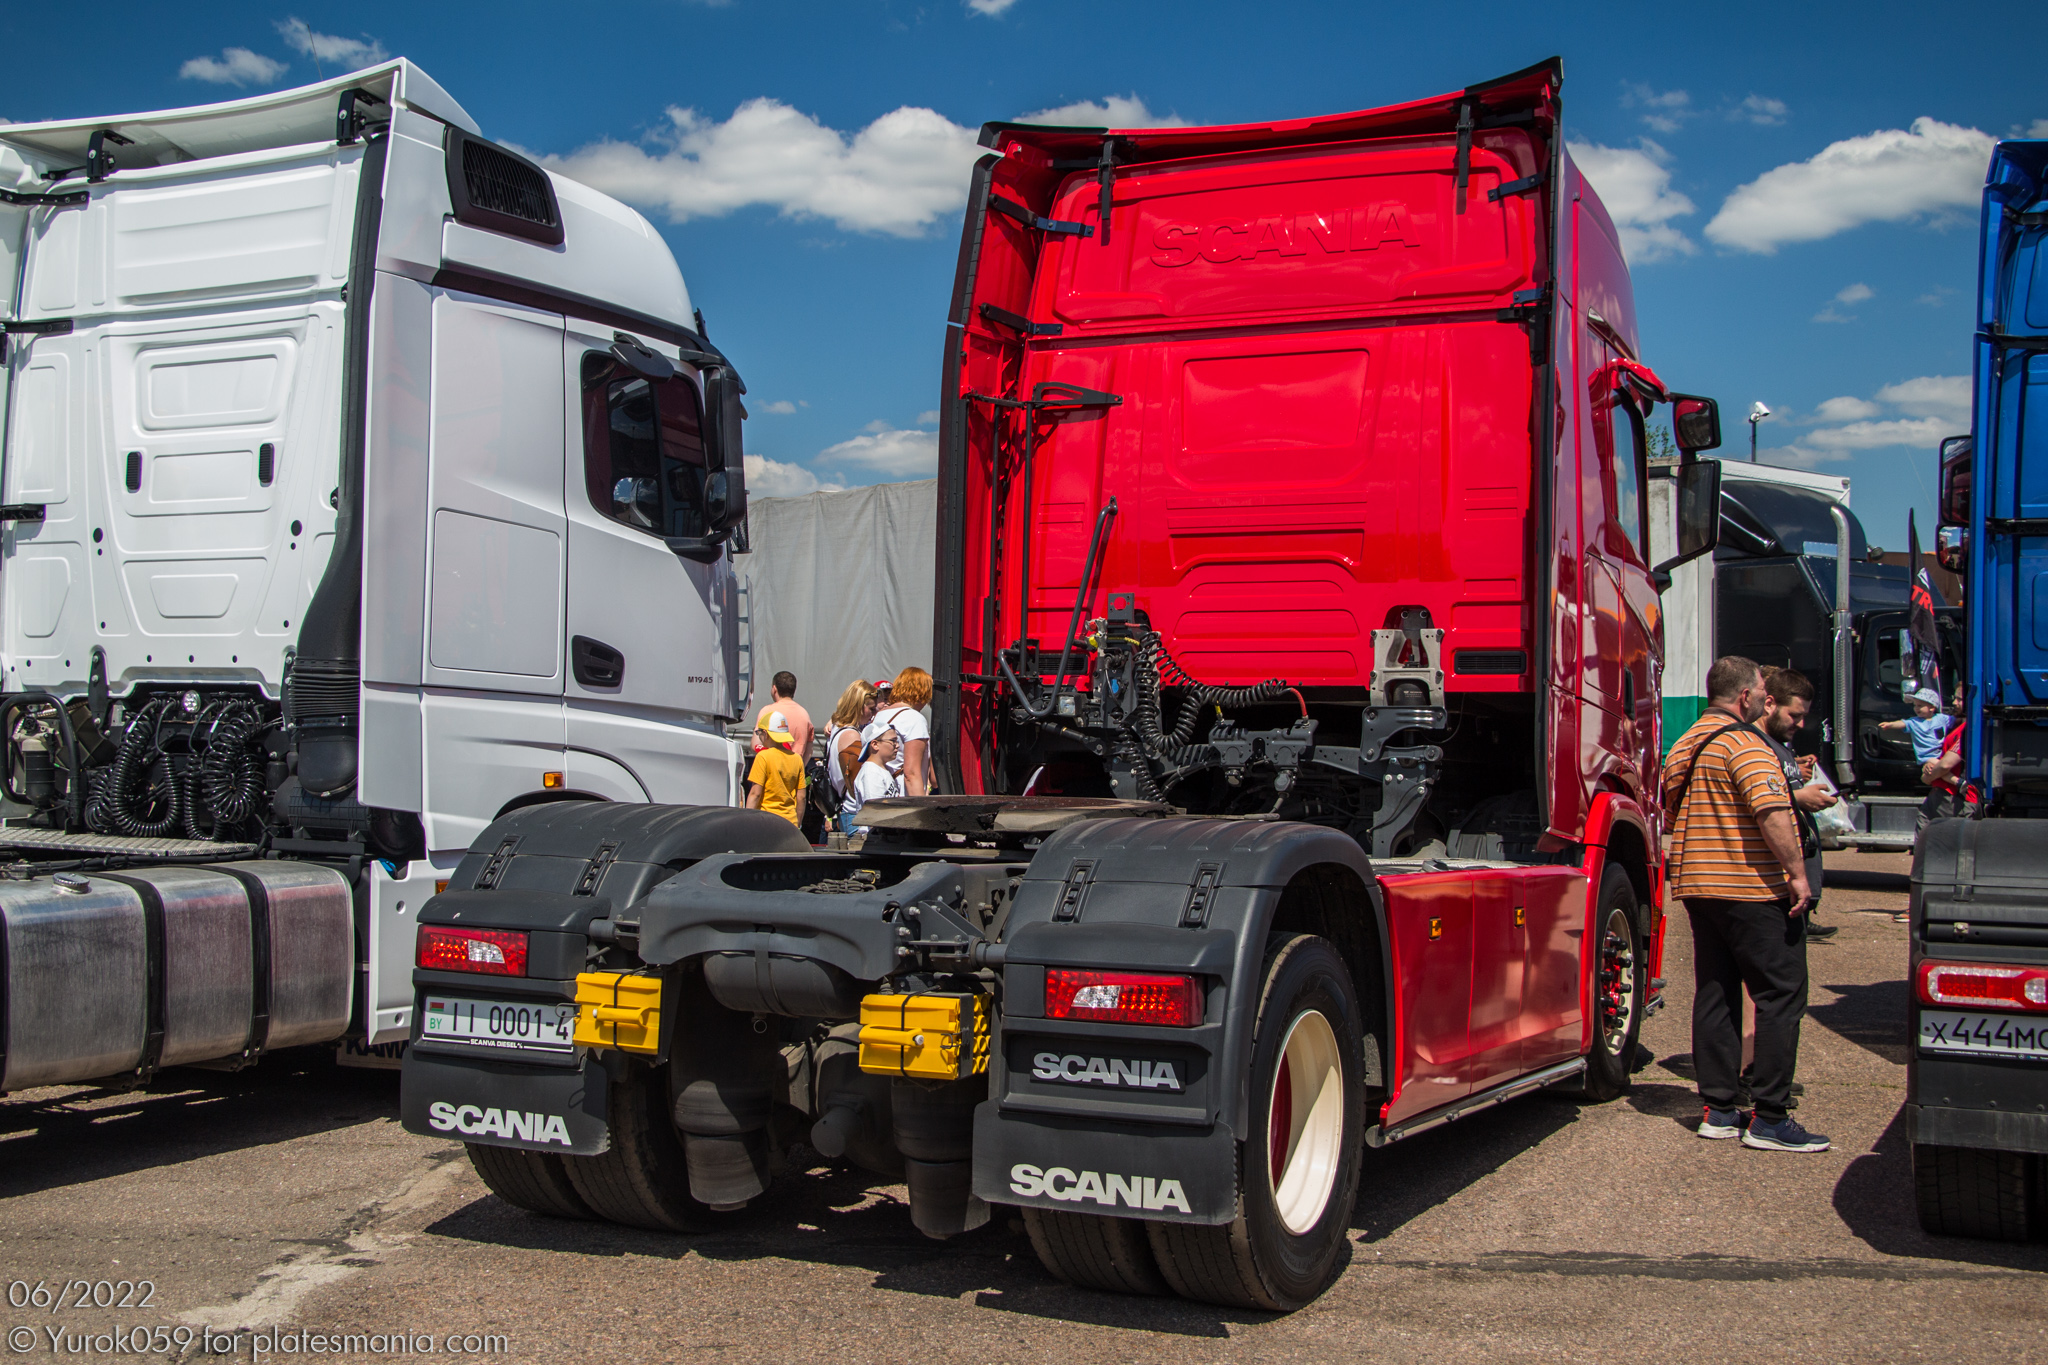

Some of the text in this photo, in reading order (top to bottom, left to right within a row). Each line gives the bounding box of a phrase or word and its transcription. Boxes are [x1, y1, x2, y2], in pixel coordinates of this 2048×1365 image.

[1150, 199, 1421, 268] SCANIA
[429, 1018, 443, 1030] BY
[489, 1005, 569, 1040] 0001-4
[1032, 1052, 1181, 1089] SCANIA
[429, 1101, 572, 1146] SCANIA
[1009, 1163, 1192, 1213] SCANIA
